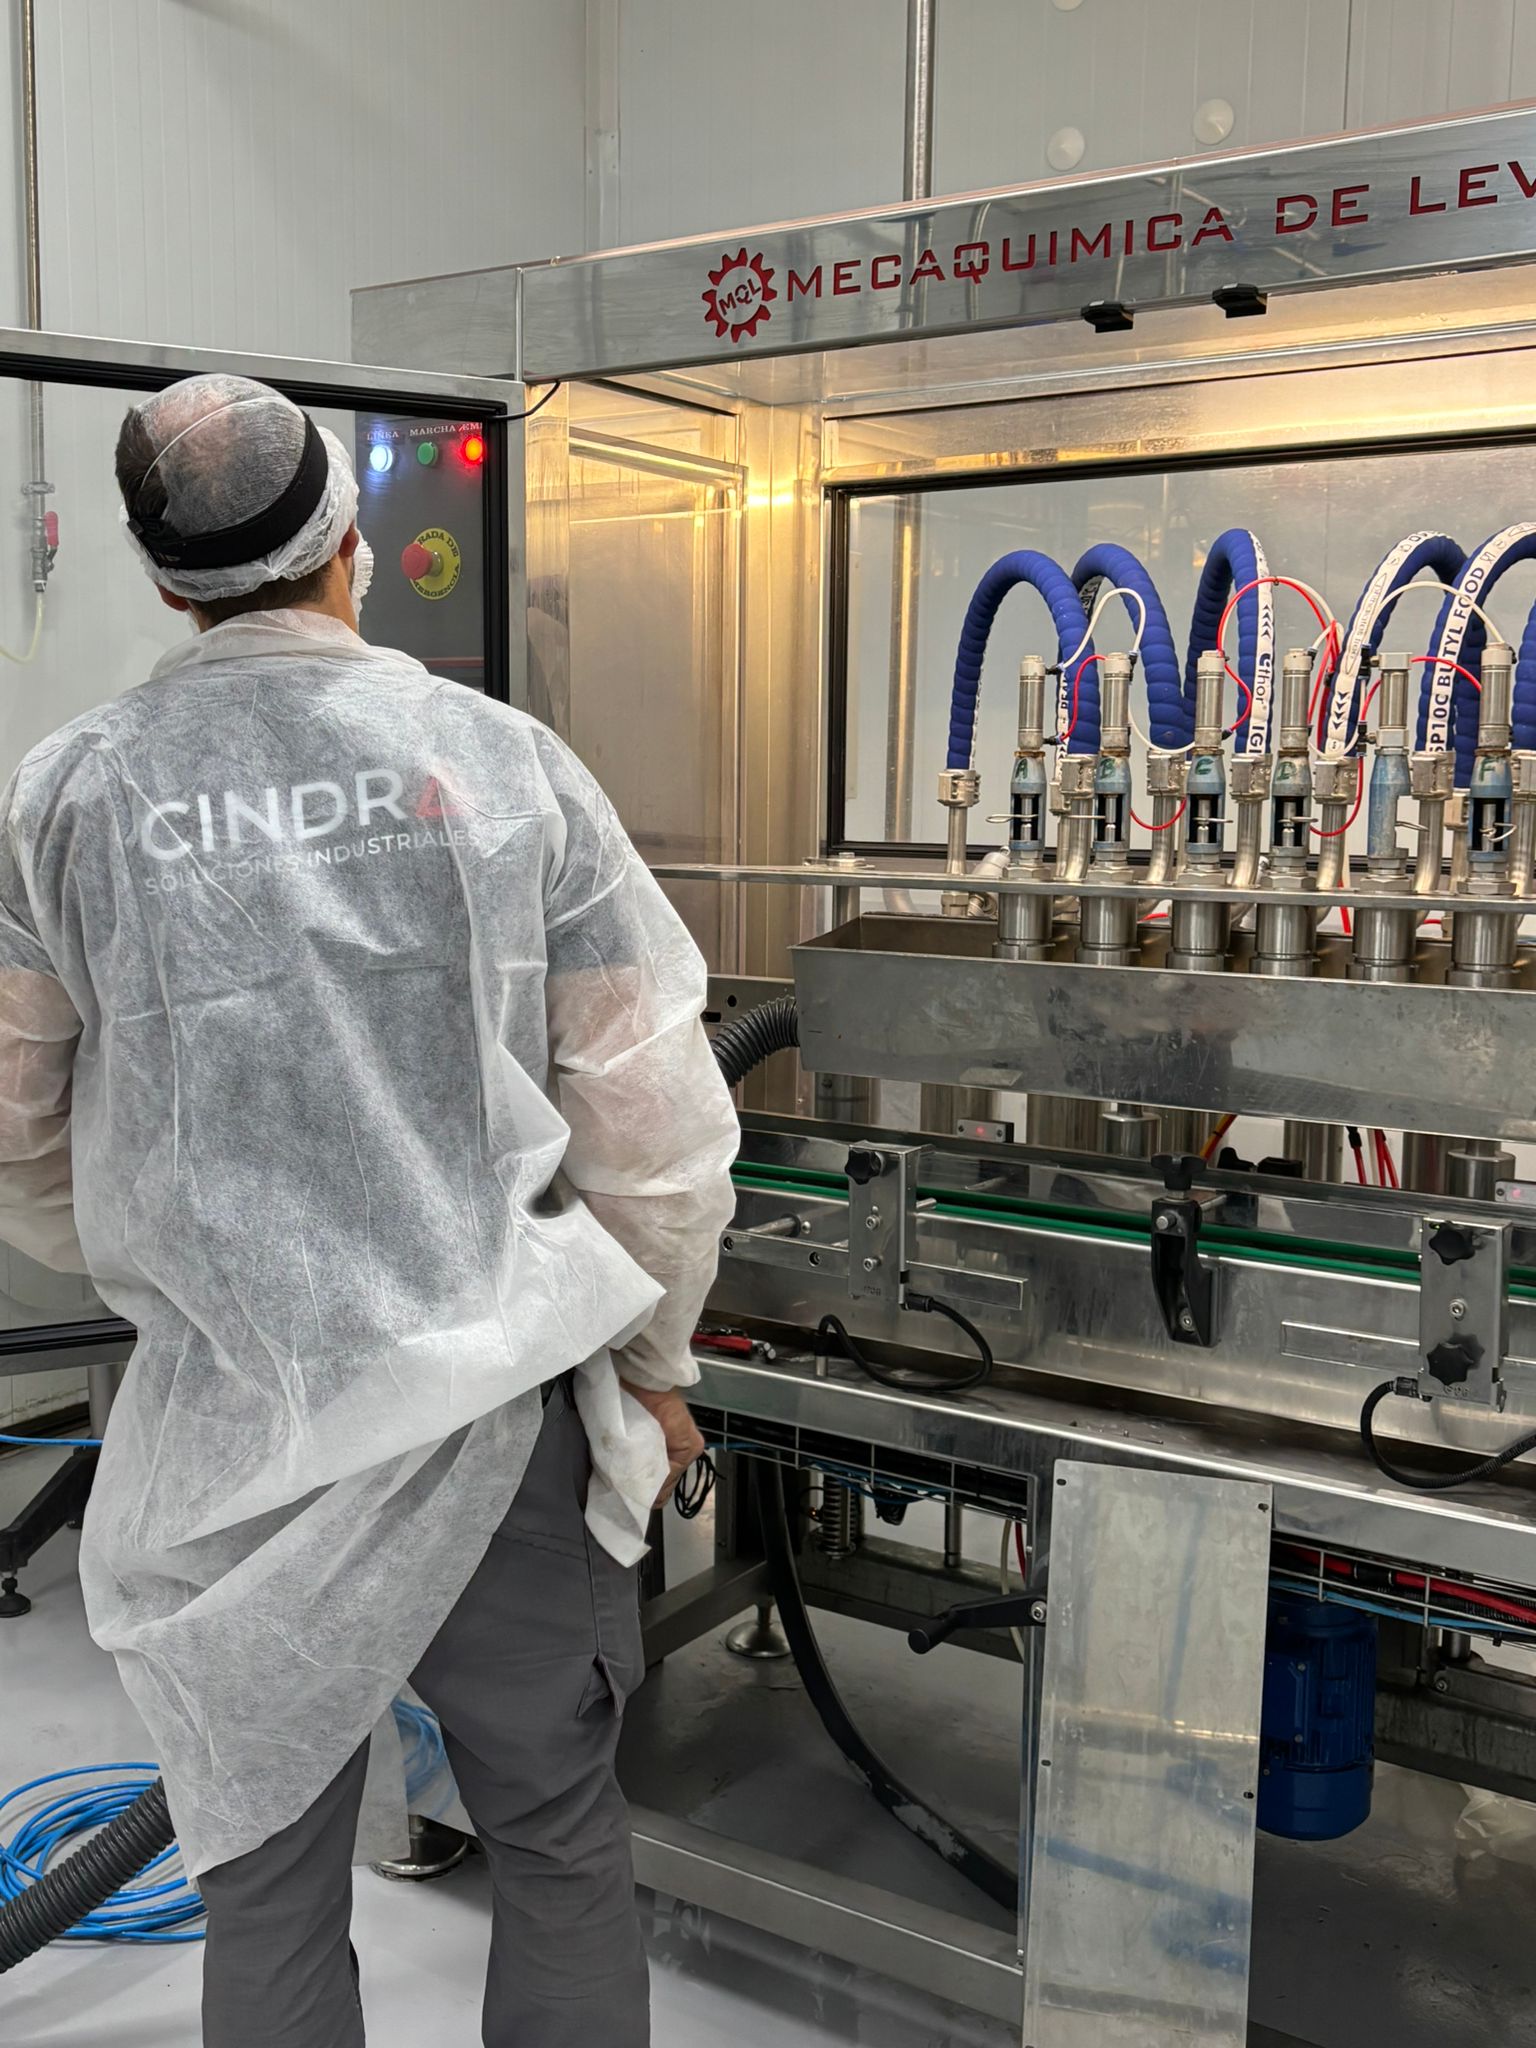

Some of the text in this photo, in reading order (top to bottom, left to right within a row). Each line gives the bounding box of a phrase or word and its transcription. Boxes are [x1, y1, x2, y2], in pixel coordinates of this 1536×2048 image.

[788, 206, 1235, 302] MECAQUIMICA
[1276, 184, 1370, 234] DE
[718, 278, 762, 317] MQL
[409, 424, 456, 437] MARCHA
[1453, 566, 1485, 620] FOOD
[1014, 758, 1029, 780] A
[1099, 758, 1117, 779] B
[1479, 755, 1501, 783] F
[306, 829, 481, 867] INDUSTRIALES
